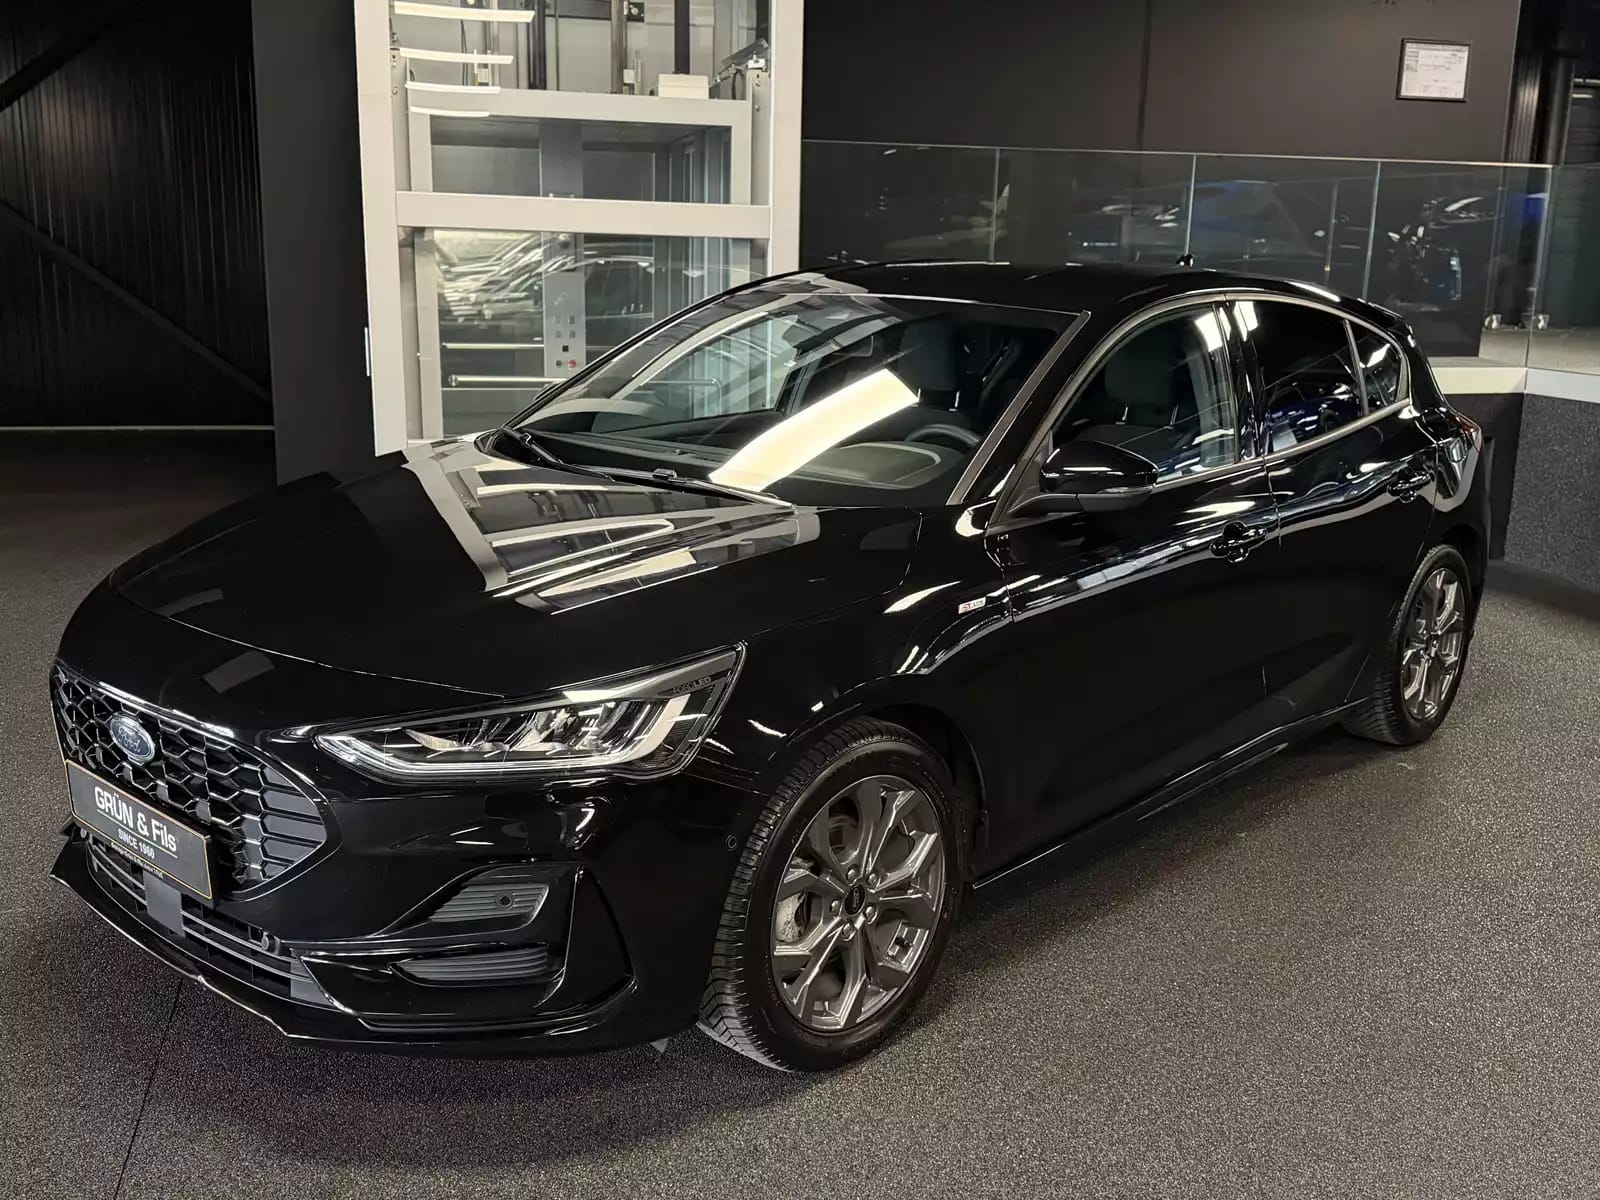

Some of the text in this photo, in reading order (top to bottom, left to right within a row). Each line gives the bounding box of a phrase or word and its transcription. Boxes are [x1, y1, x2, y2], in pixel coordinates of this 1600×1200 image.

[95, 786, 177, 852] GRÜN & Fils
[118, 829, 155, 859] SINCE 1960
